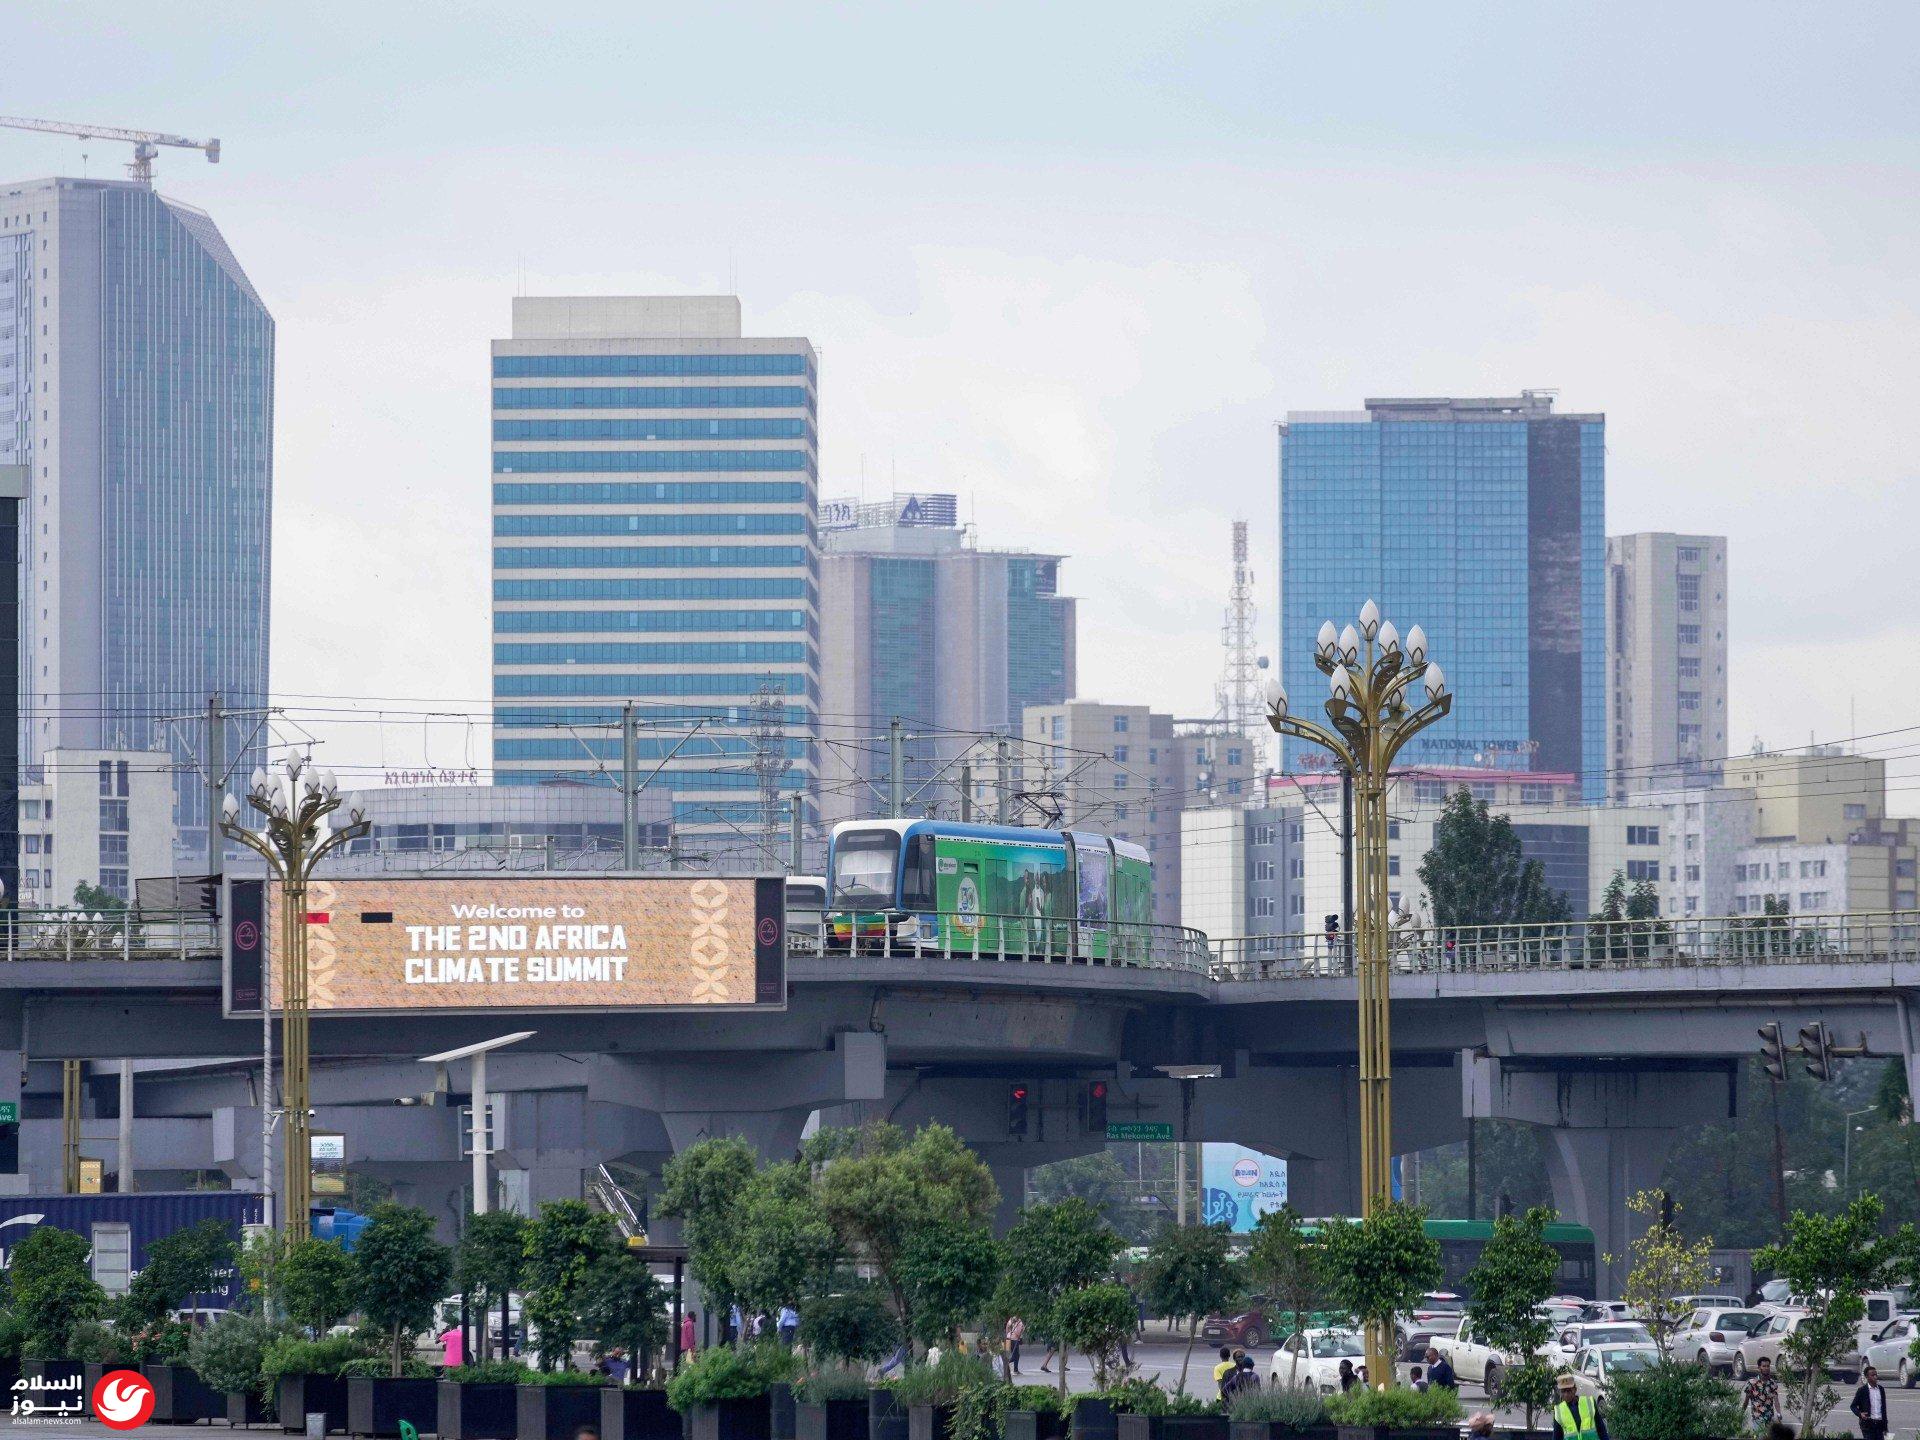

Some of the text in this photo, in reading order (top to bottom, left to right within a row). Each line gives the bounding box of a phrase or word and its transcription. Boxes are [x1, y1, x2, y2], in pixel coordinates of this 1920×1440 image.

[1421, 739, 1478, 750] NATIONAL
[1481, 739, 1519, 751] TOWER
[451, 904, 585, 919] Welcome to
[406, 924, 627, 951] THE 2ND AFRICA
[405, 956, 628, 984] CLIMATE SUMMIT
[1121, 1132, 1155, 1140] Mekonen
